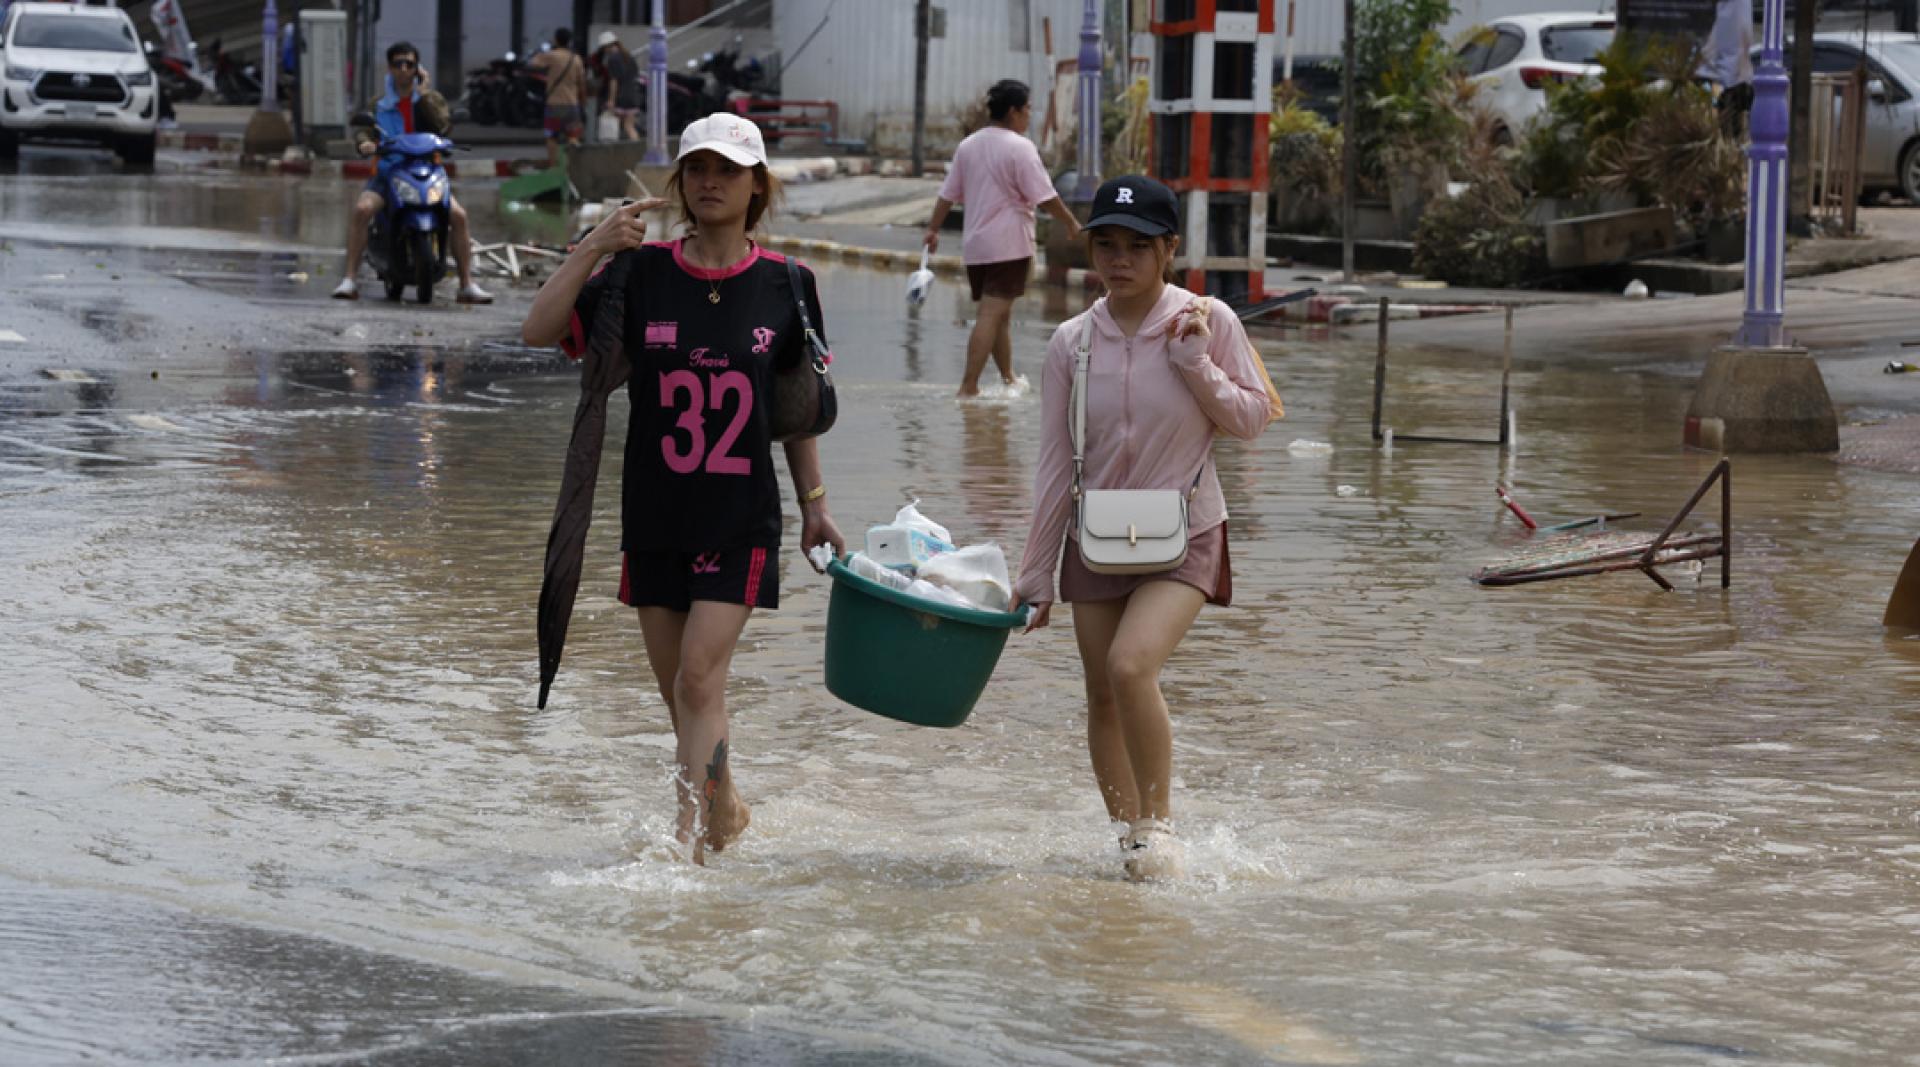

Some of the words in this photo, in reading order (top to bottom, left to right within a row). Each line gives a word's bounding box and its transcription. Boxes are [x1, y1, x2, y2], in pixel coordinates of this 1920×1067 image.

[1115, 187, 1135, 204] R
[689, 348, 730, 368] Travis
[659, 369, 753, 475] 32
